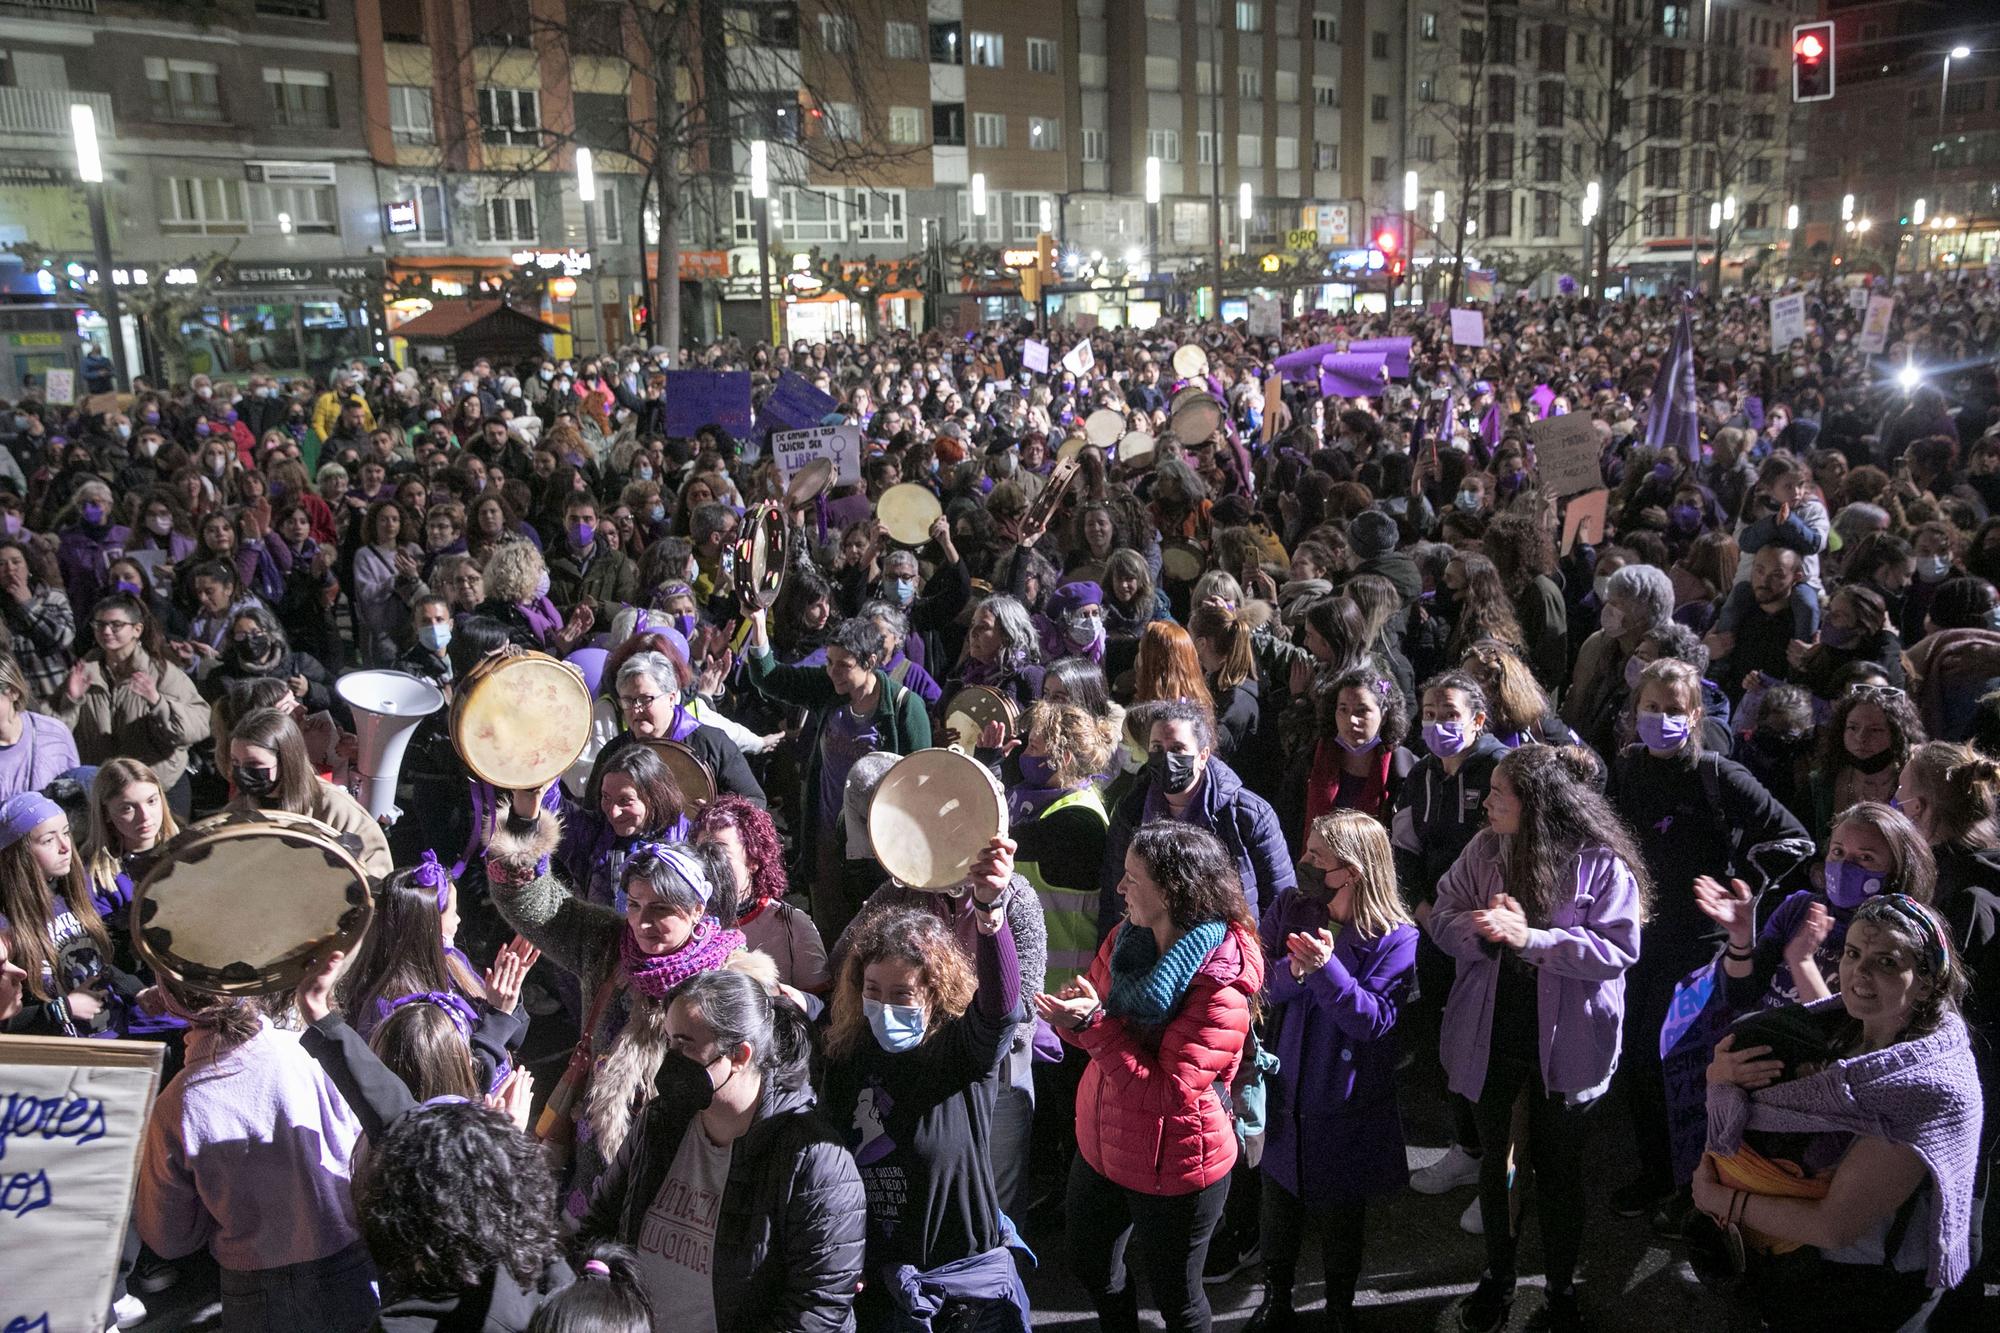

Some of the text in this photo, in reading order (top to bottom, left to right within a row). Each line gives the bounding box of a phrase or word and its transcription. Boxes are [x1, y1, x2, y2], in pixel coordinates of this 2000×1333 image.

[1289, 230, 1317, 246] ORO
[239, 267, 366, 281] ESTRELLA PARK
[776, 433, 785, 442] DE
[1669, 977, 1715, 1022] TEN
[0, 1168, 52, 1218] os
[896, 1193, 908, 1204] DA
[640, 1218, 709, 1275] WOMA
